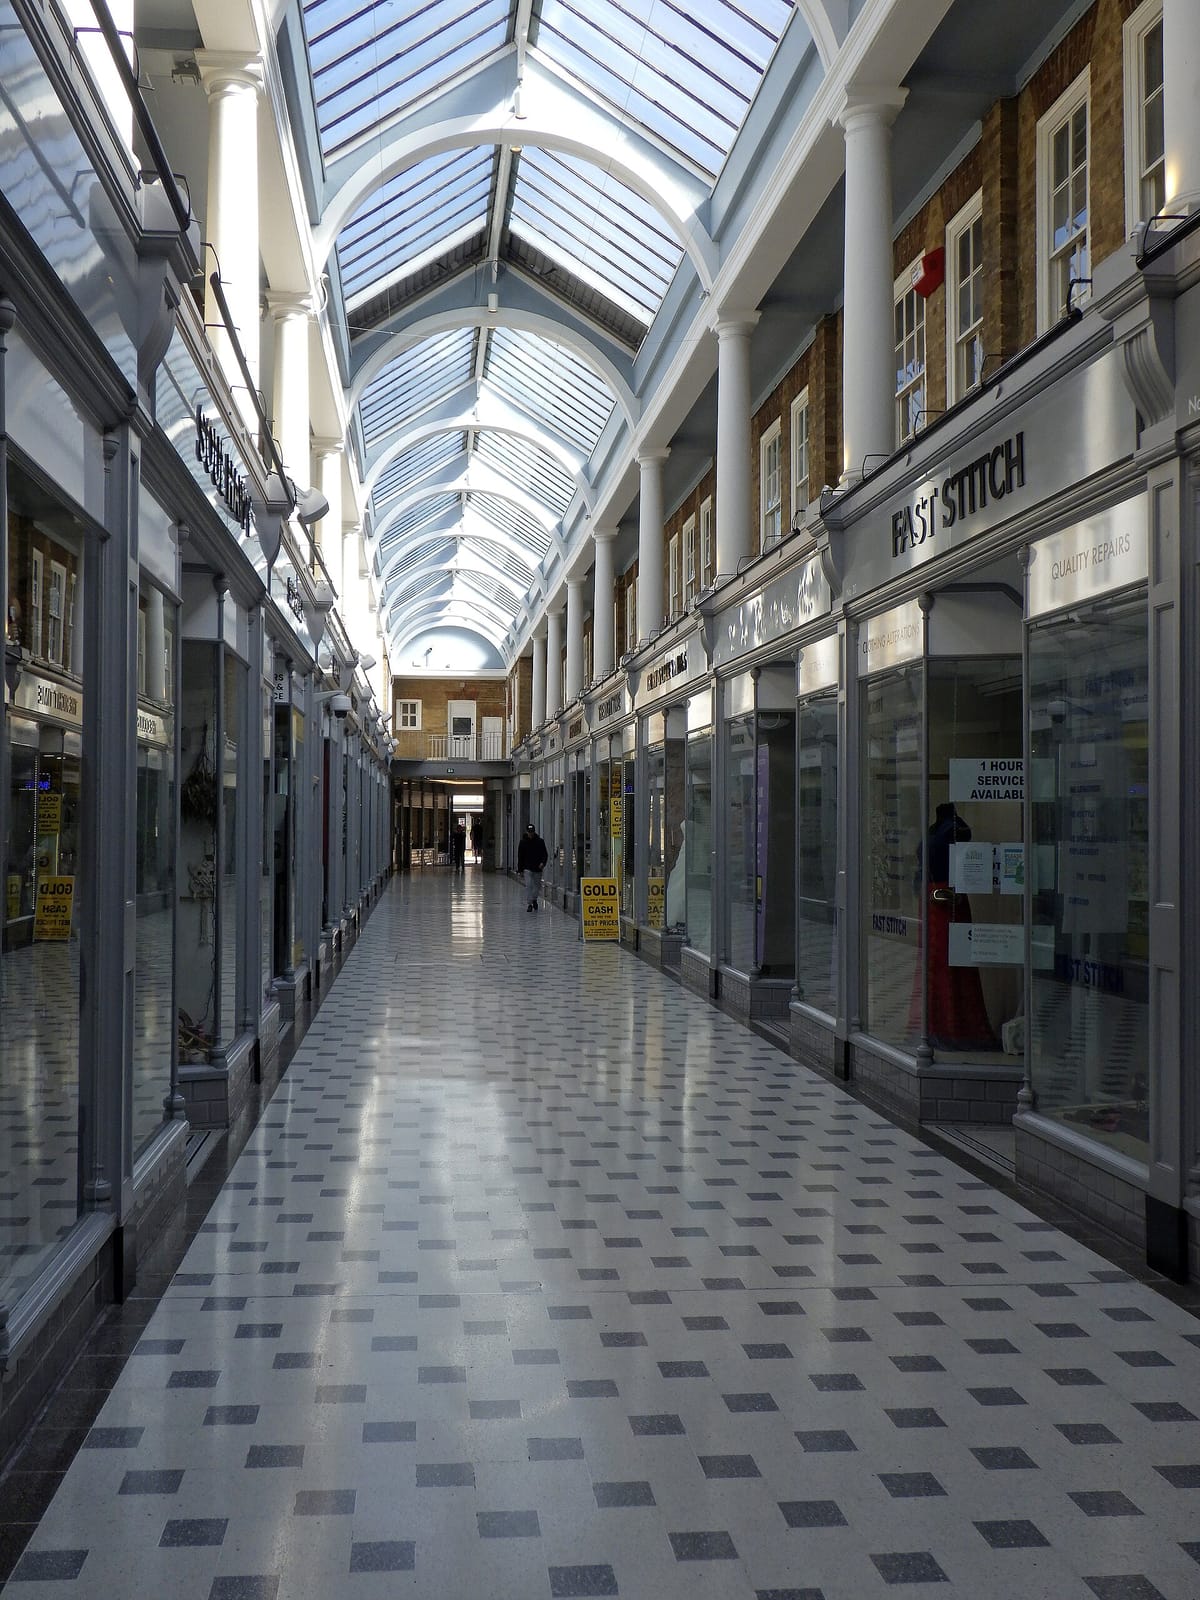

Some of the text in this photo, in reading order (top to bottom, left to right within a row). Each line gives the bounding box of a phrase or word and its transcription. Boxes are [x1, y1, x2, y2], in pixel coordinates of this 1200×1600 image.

[891, 431, 1025, 557] FAST STITCH
[1051, 533, 1131, 581] QUALITY REPAIRS
[862, 622, 920, 655] CLOTHING ALTERATIONS
[980, 761, 1023, 771] 1 HOUR
[970, 789, 1024, 800] AVAILABL
[583, 884, 617, 897] GOLD
[588, 905, 613, 914] CASH
[584, 919, 619, 927] BEST PRICES
[872, 913, 907, 937] FAST STITCH
